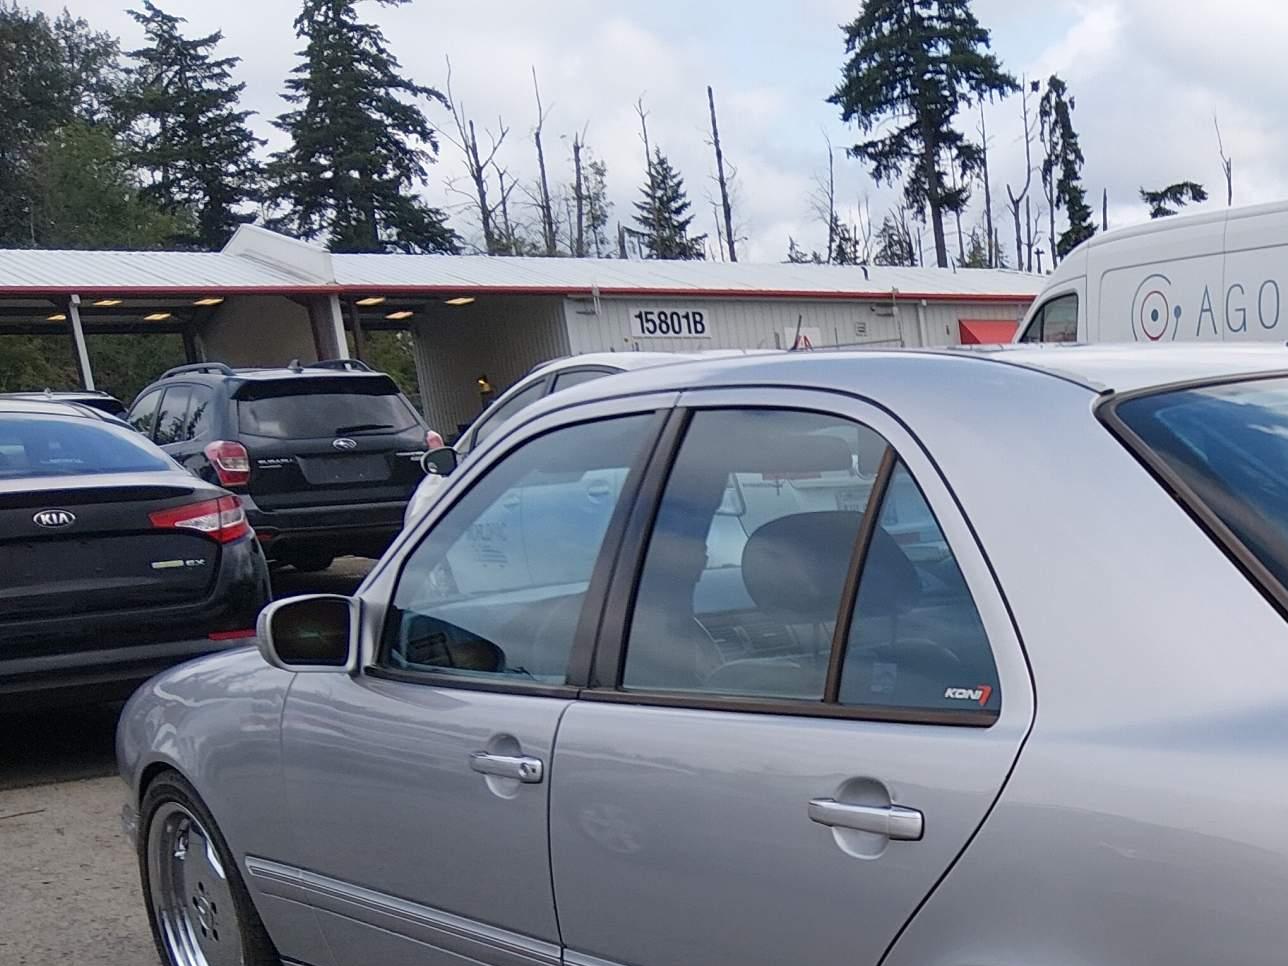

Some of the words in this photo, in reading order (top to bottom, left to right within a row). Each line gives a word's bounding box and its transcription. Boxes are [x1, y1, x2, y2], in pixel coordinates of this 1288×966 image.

[634, 310, 706, 335] 15801B
[40, 513, 70, 525] KIA
[944, 687, 983, 700] KONI
